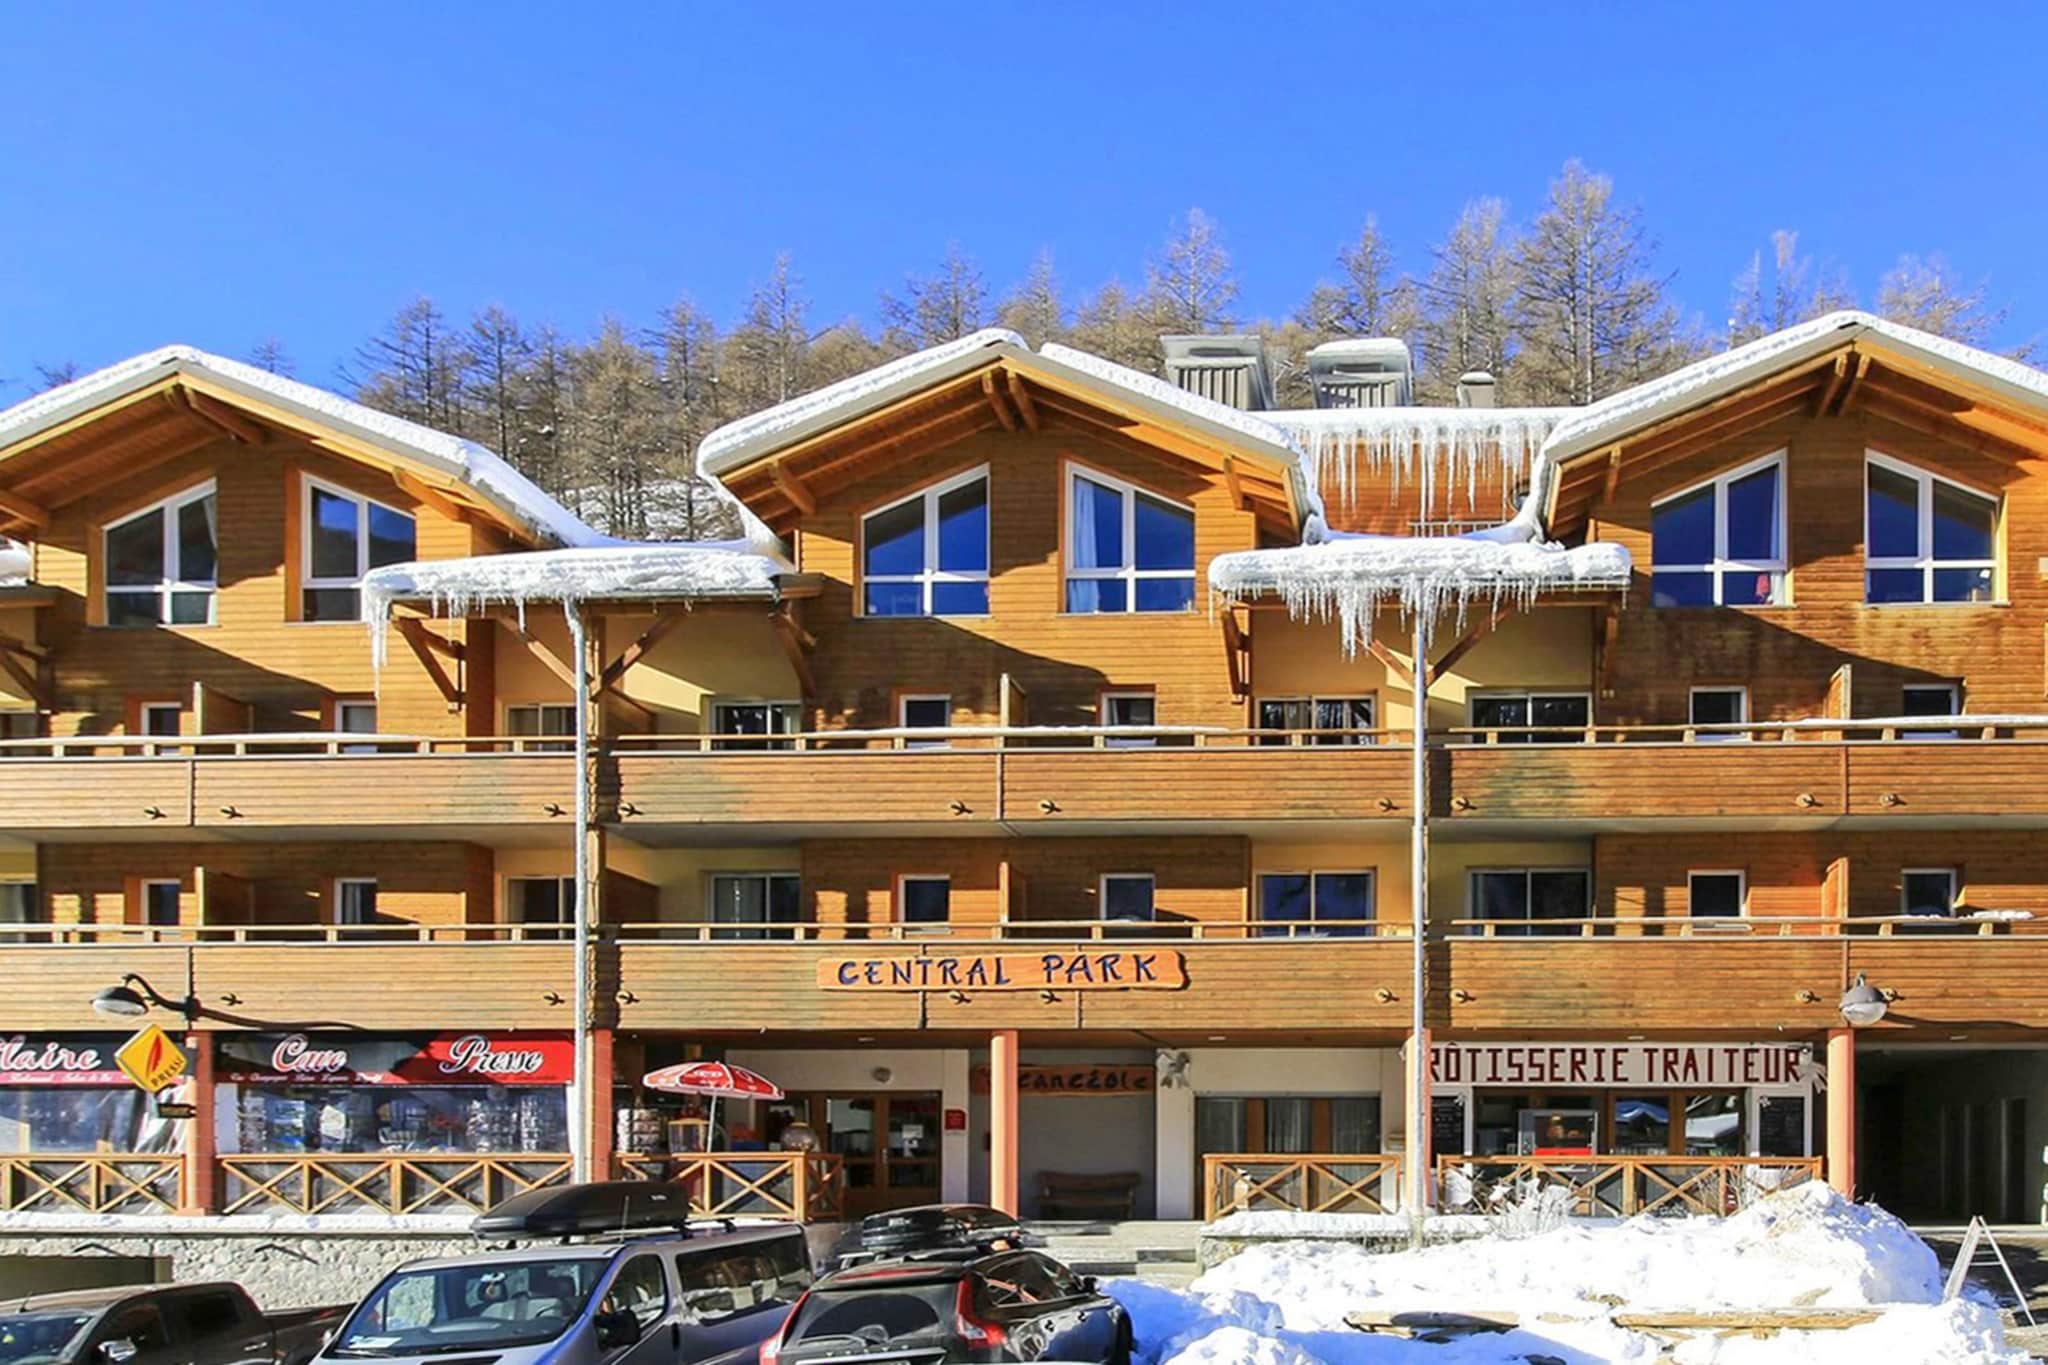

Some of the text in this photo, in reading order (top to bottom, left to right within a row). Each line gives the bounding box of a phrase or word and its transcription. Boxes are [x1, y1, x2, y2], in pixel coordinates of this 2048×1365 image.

[838, 953, 1158, 985] CENTRAL PARK
[272, 1033, 347, 1073] Cave
[439, 1035, 544, 1074] Presse
[1643, 1048, 1801, 1082] TRAITEUR
